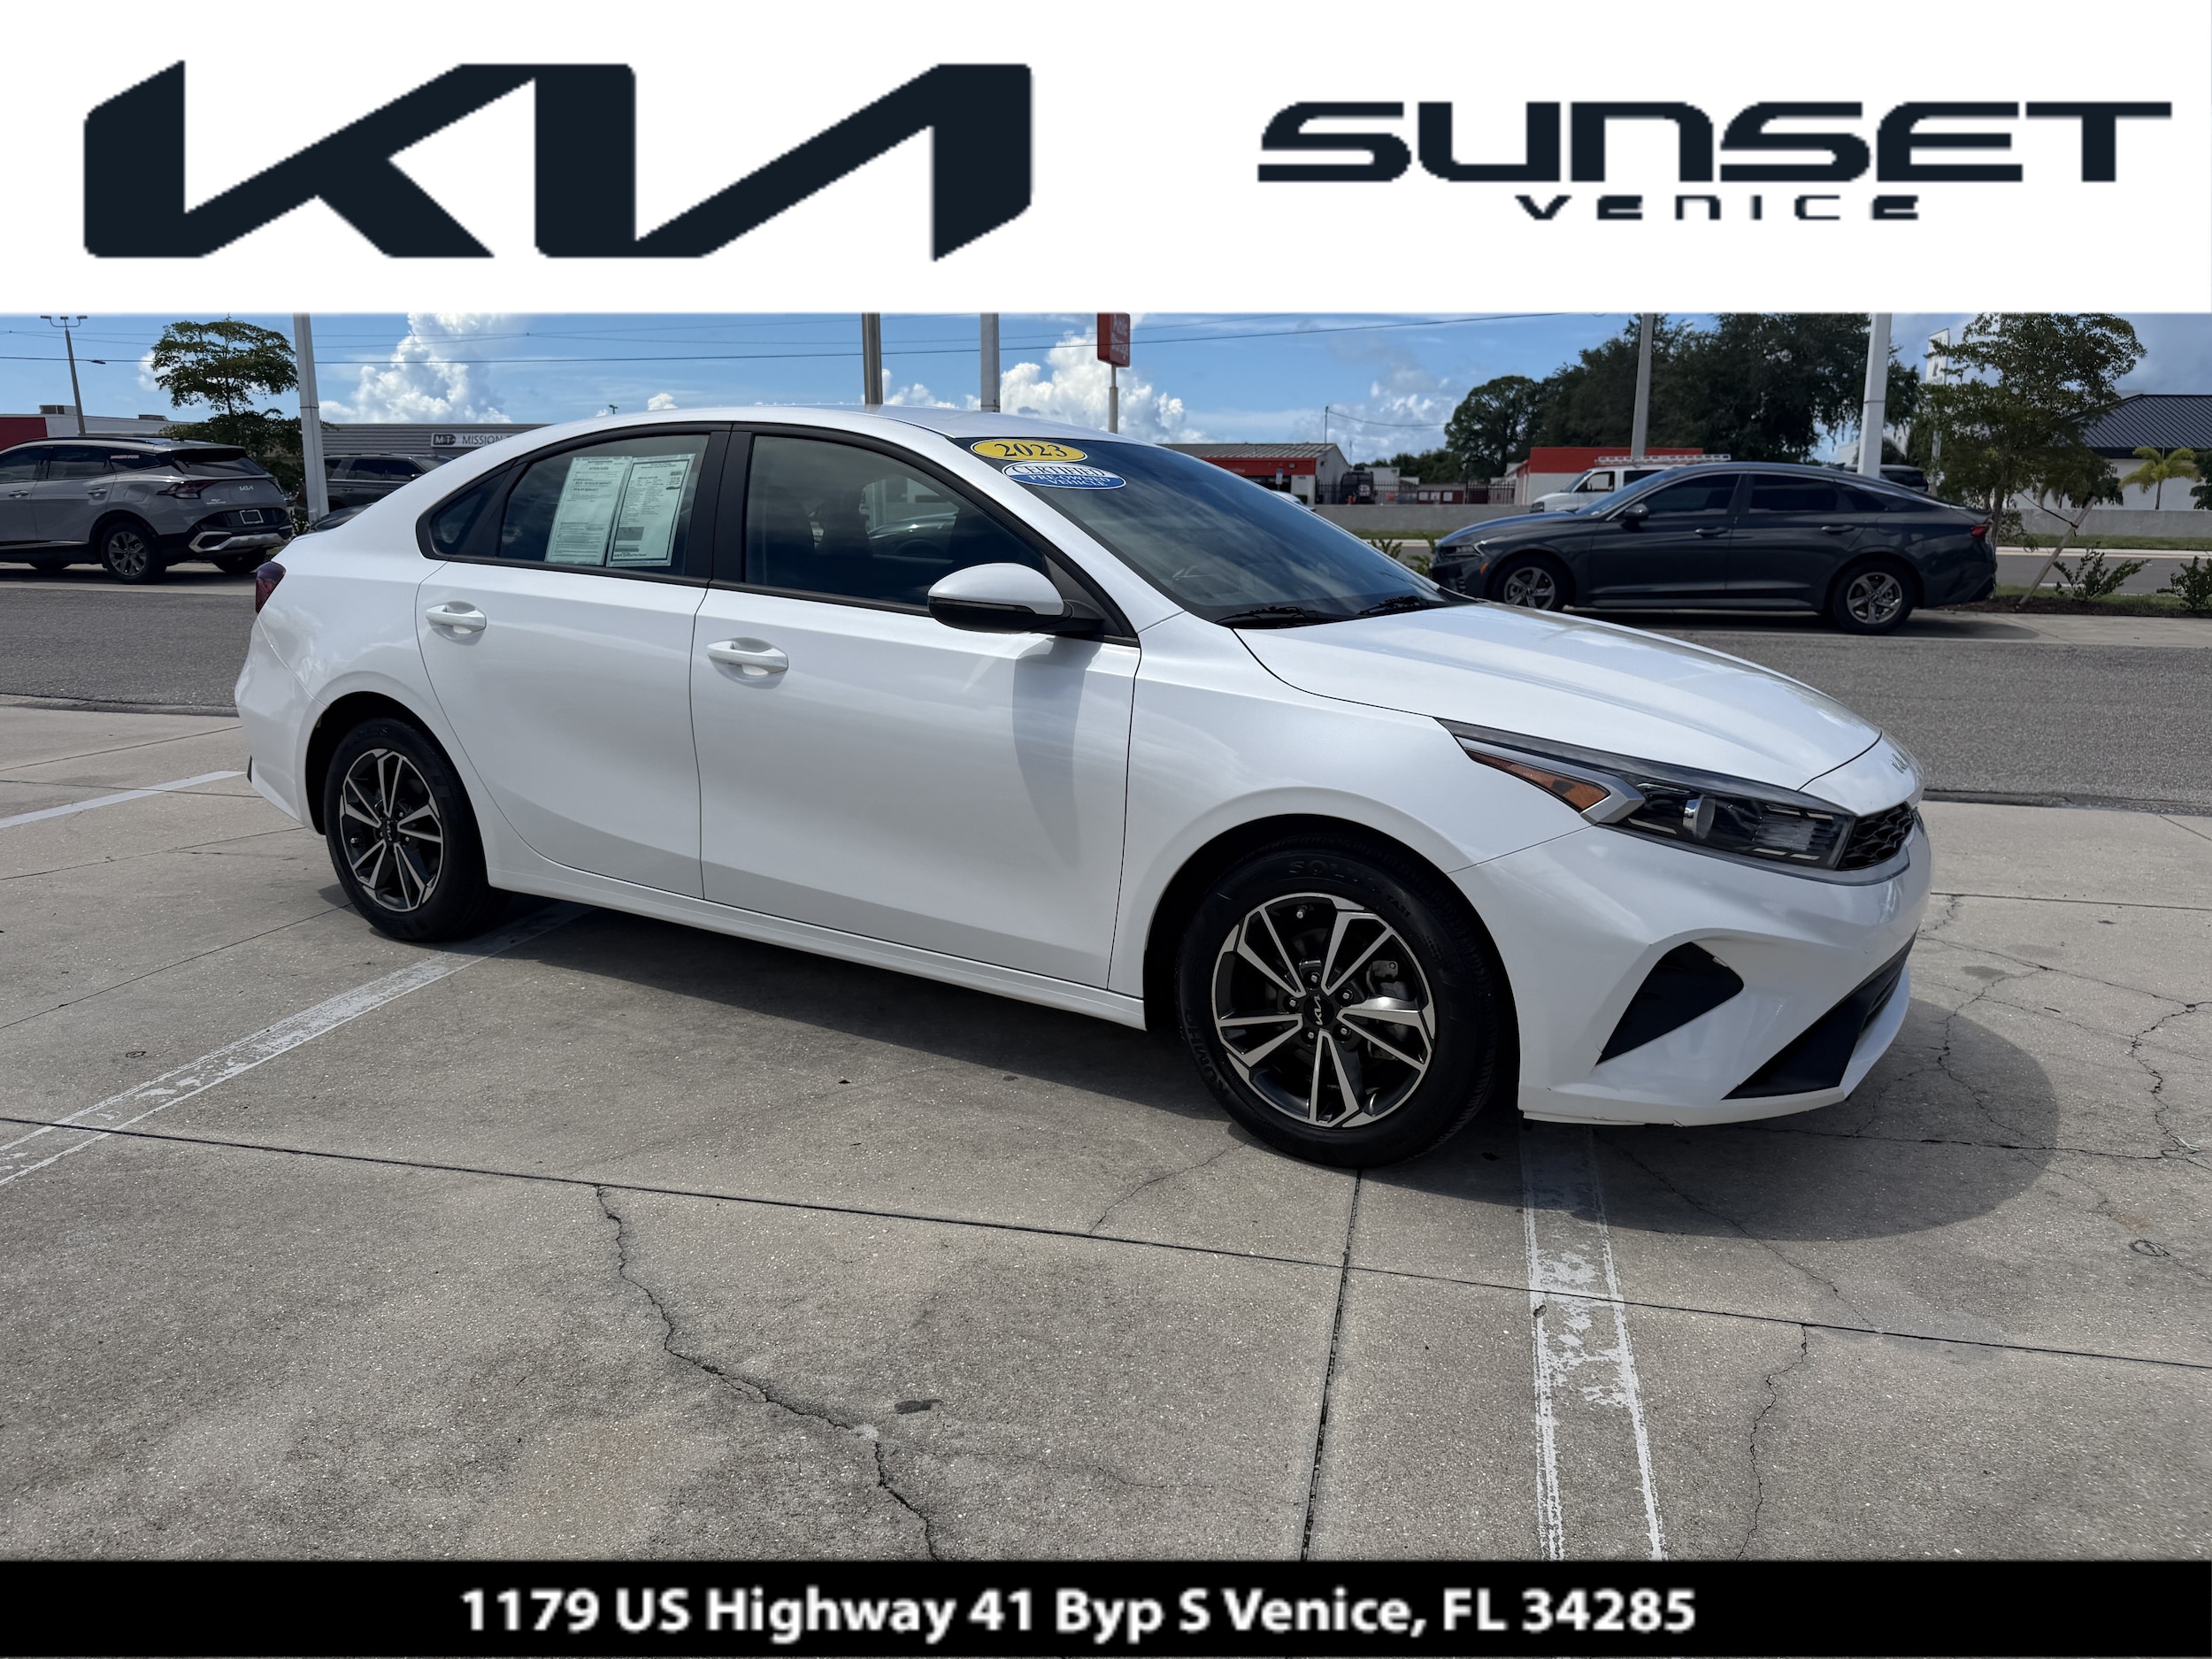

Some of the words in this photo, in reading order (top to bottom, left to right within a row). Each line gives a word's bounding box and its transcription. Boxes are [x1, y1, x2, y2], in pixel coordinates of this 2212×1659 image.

[462, 434, 503, 445] MISSION
[994, 442, 1068, 457] 2023
[1011, 465, 1107, 478] CERTIFIED
[1028, 473, 1110, 483] PRE-OWNED
[1048, 478, 1108, 488] VEHICLE
